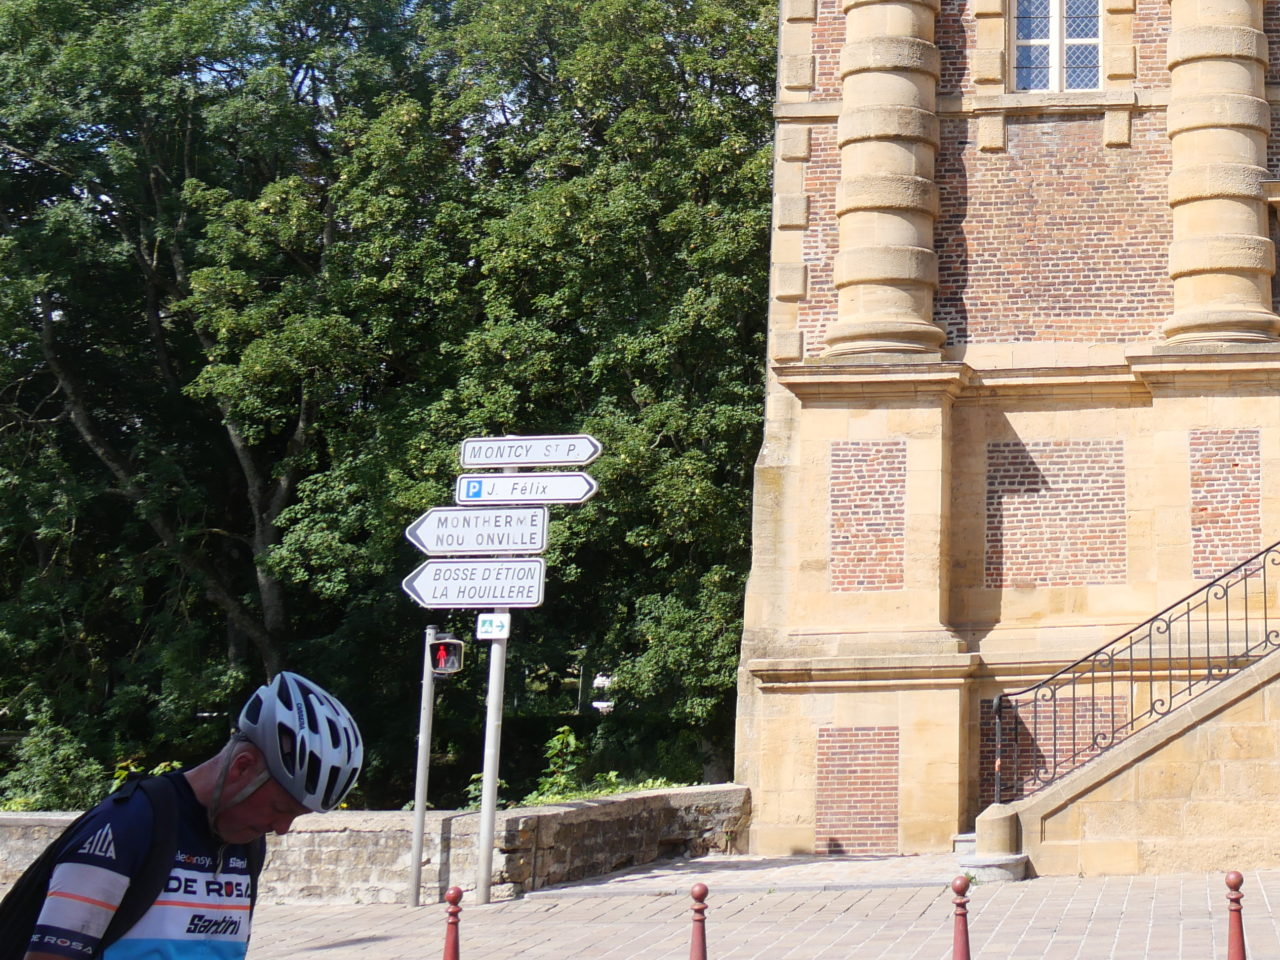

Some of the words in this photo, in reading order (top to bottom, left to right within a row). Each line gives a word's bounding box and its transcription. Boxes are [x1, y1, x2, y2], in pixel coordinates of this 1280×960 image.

[469, 444, 532, 459] MONTCY
[511, 482, 548, 496] Félix
[437, 511, 539, 529] MONTHERMÉ
[435, 532, 538, 547] NOUONVILLE
[433, 568, 478, 581] BOSSE
[481, 563, 536, 581] D'ÉTION
[432, 586, 448, 600] LA
[457, 585, 535, 600] HOUILLERE
[163, 876, 197, 895] DE
[186, 914, 242, 936] Santini
[44, 935, 93, 955] ROSA
